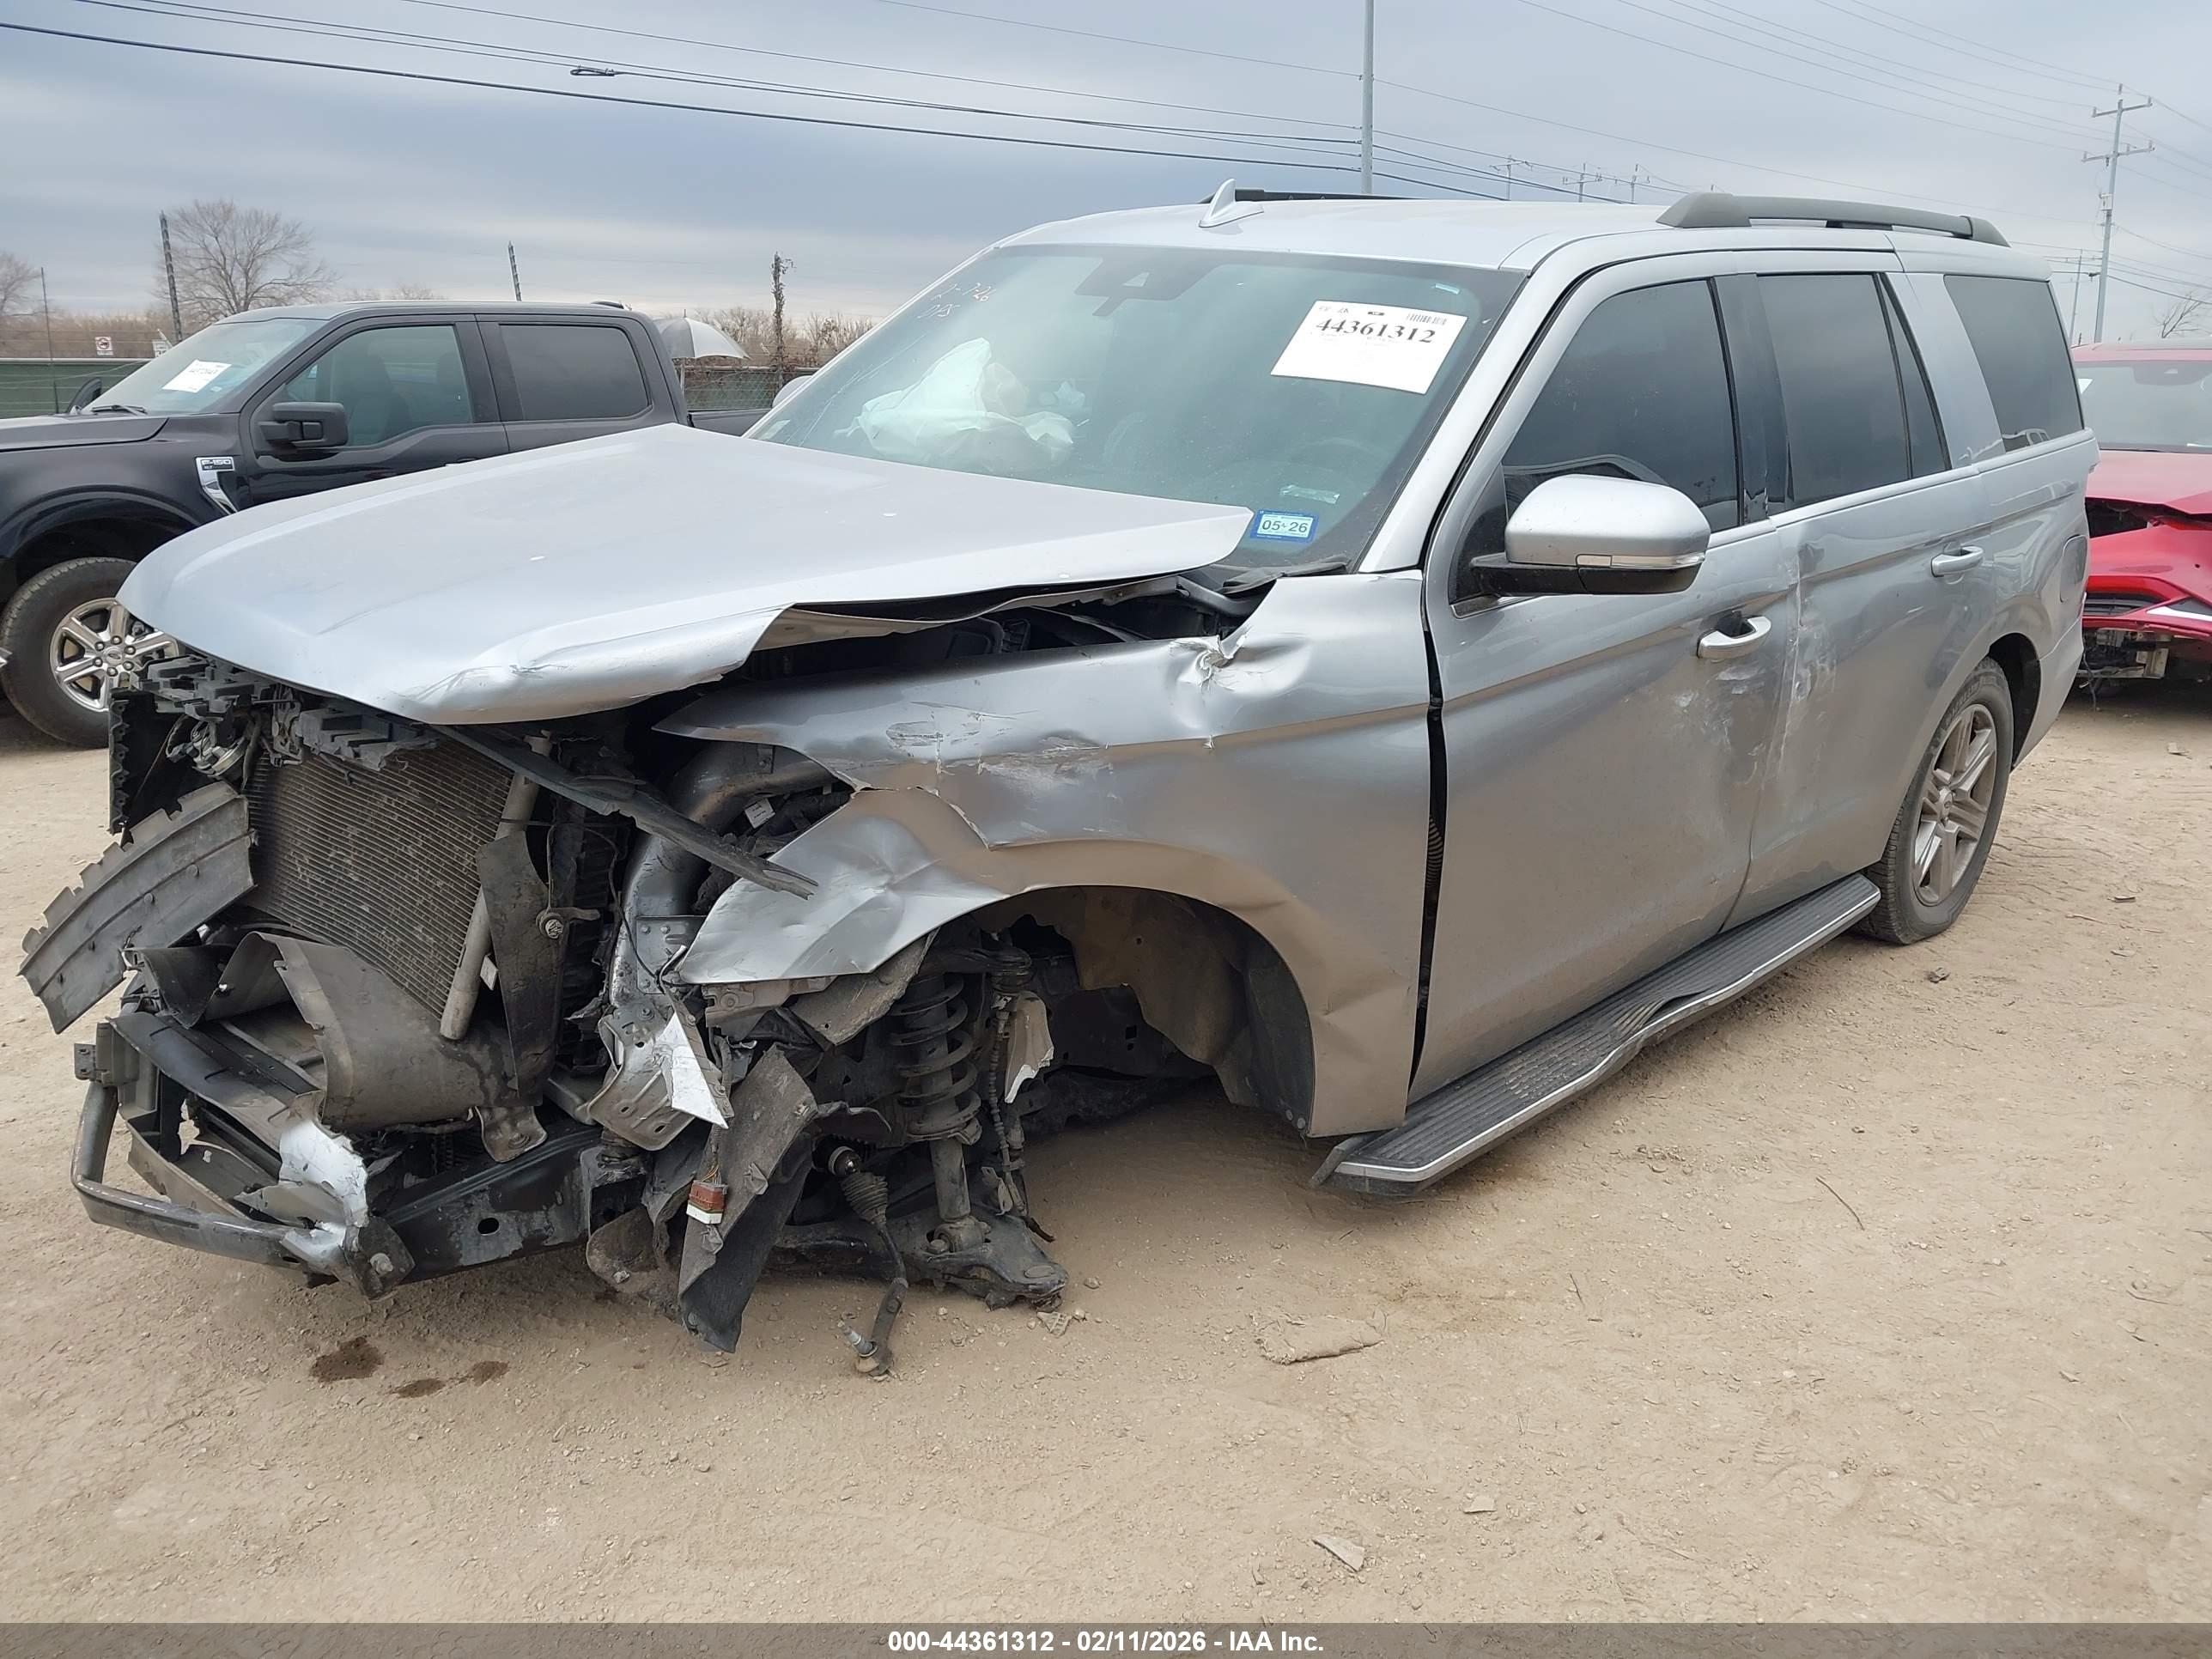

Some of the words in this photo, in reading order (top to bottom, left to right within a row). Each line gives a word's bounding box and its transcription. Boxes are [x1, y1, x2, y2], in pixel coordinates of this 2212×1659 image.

[1316, 318, 1436, 343] 44361312
[1261, 520, 1281, 531] 05
[1288, 521, 1309, 532] 26
